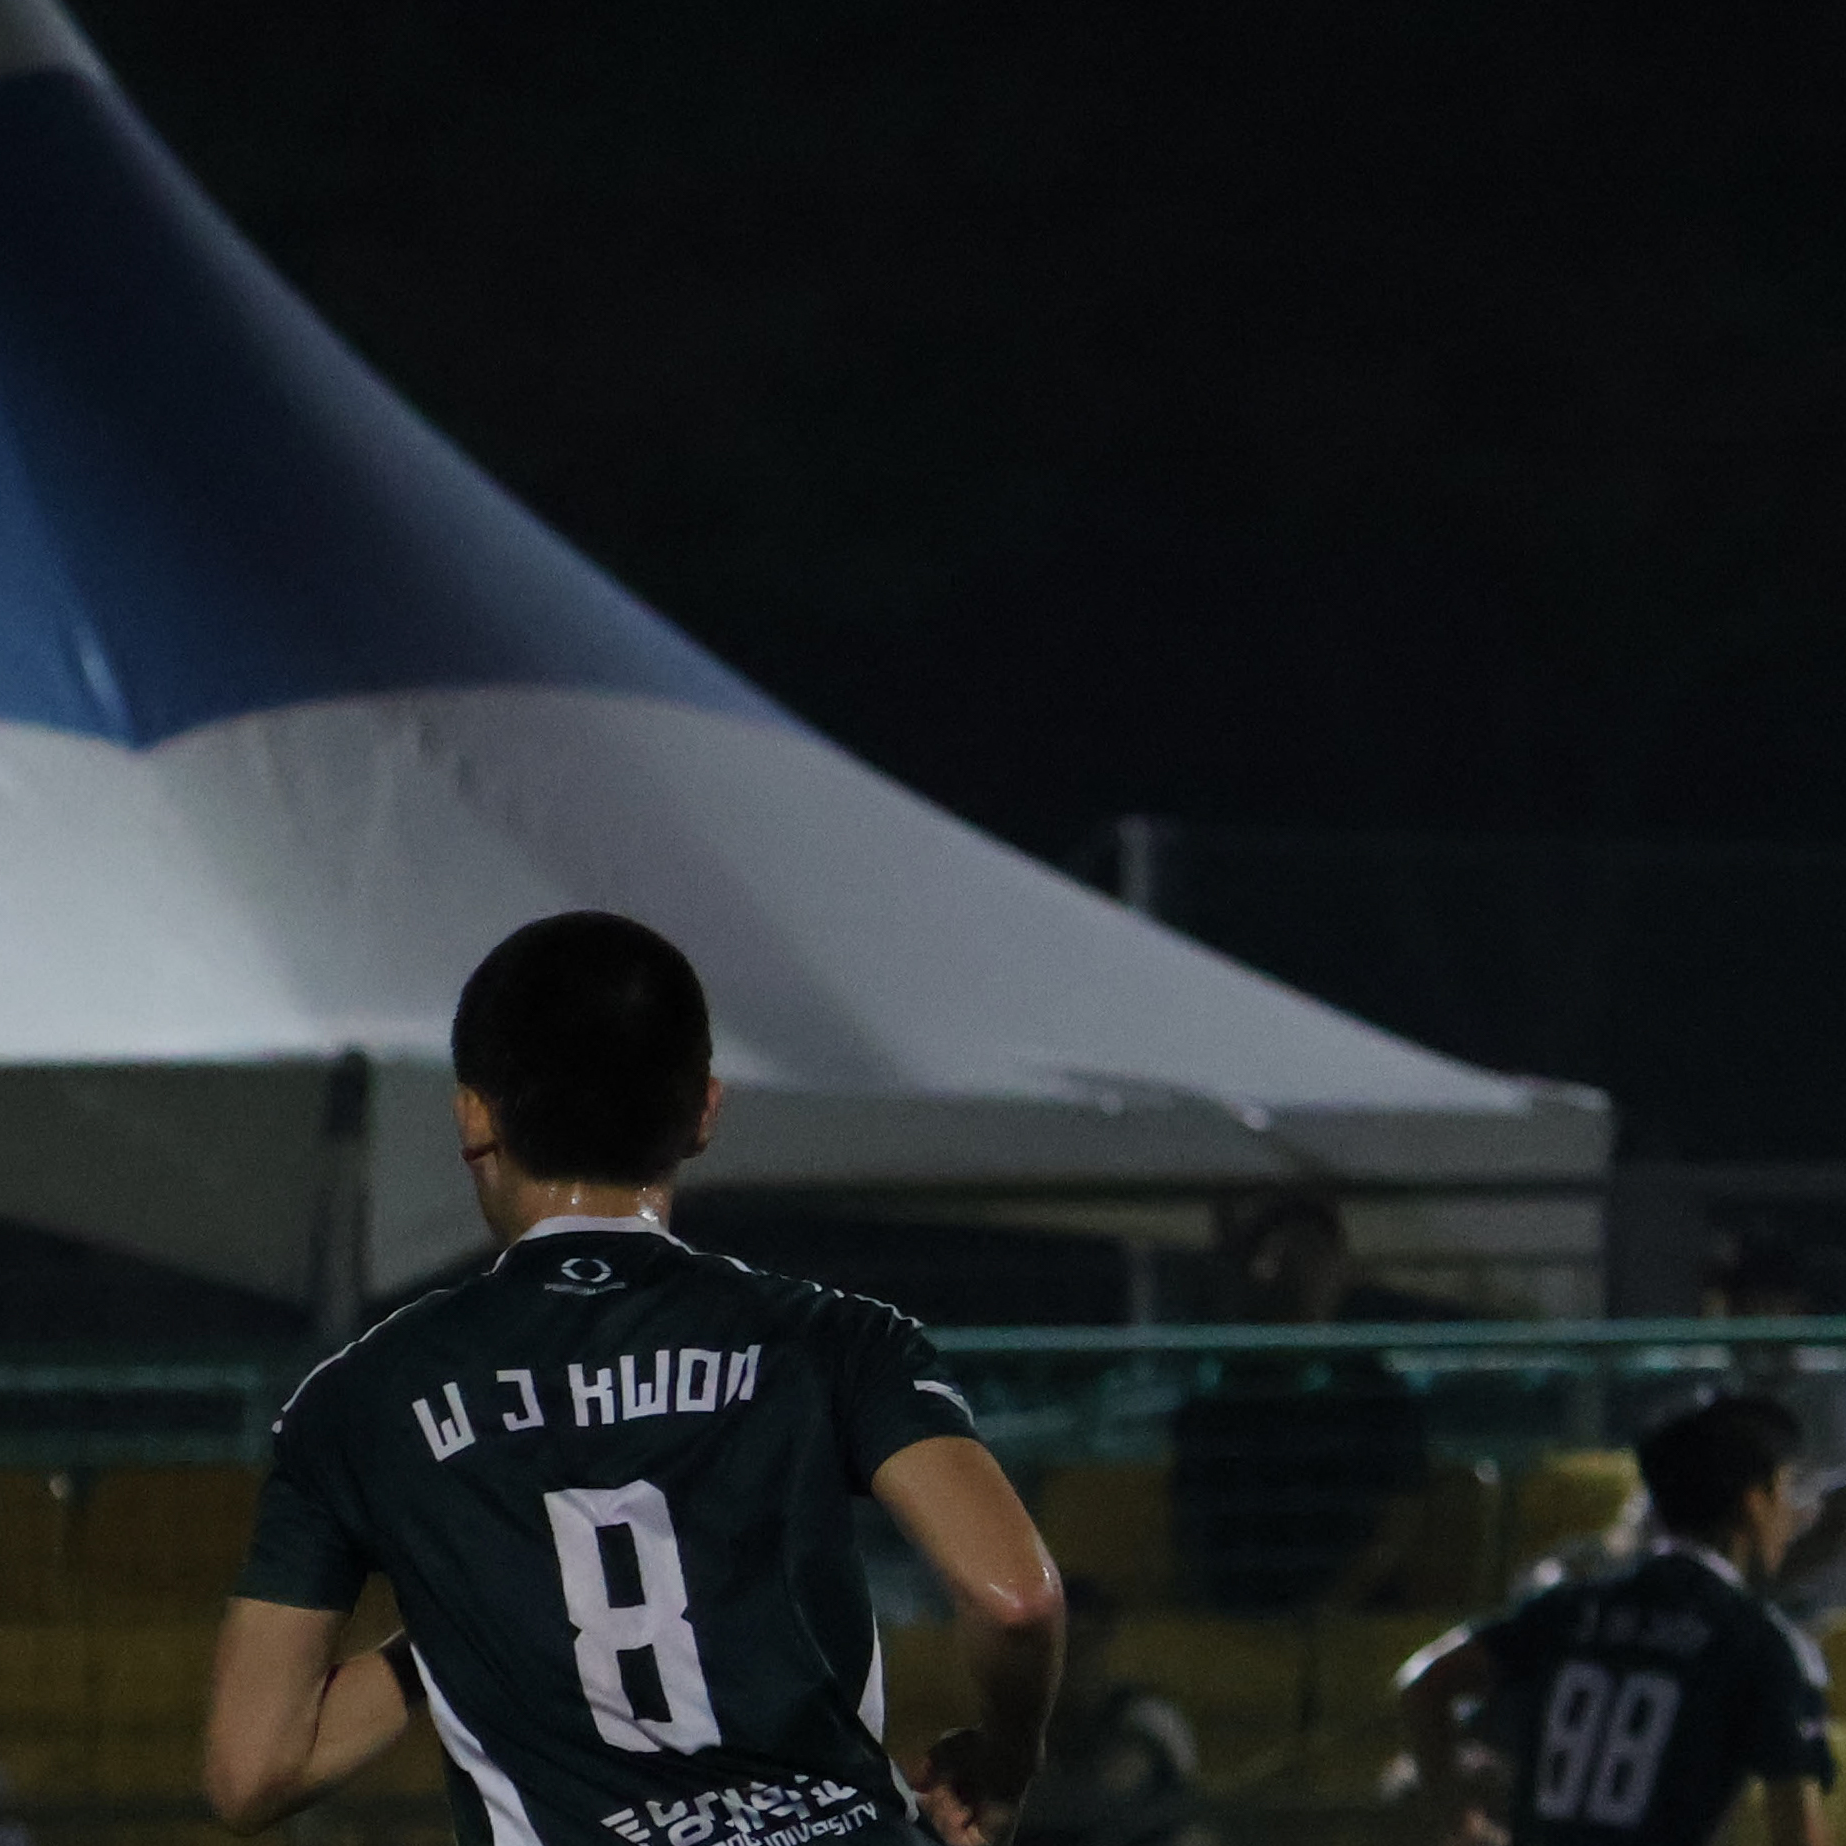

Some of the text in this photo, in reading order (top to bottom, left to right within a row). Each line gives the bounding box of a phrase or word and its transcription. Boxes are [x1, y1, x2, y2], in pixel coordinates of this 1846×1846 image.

[412, 1344, 761, 1461] W J KWON
[544, 1480, 721, 1754] 8
